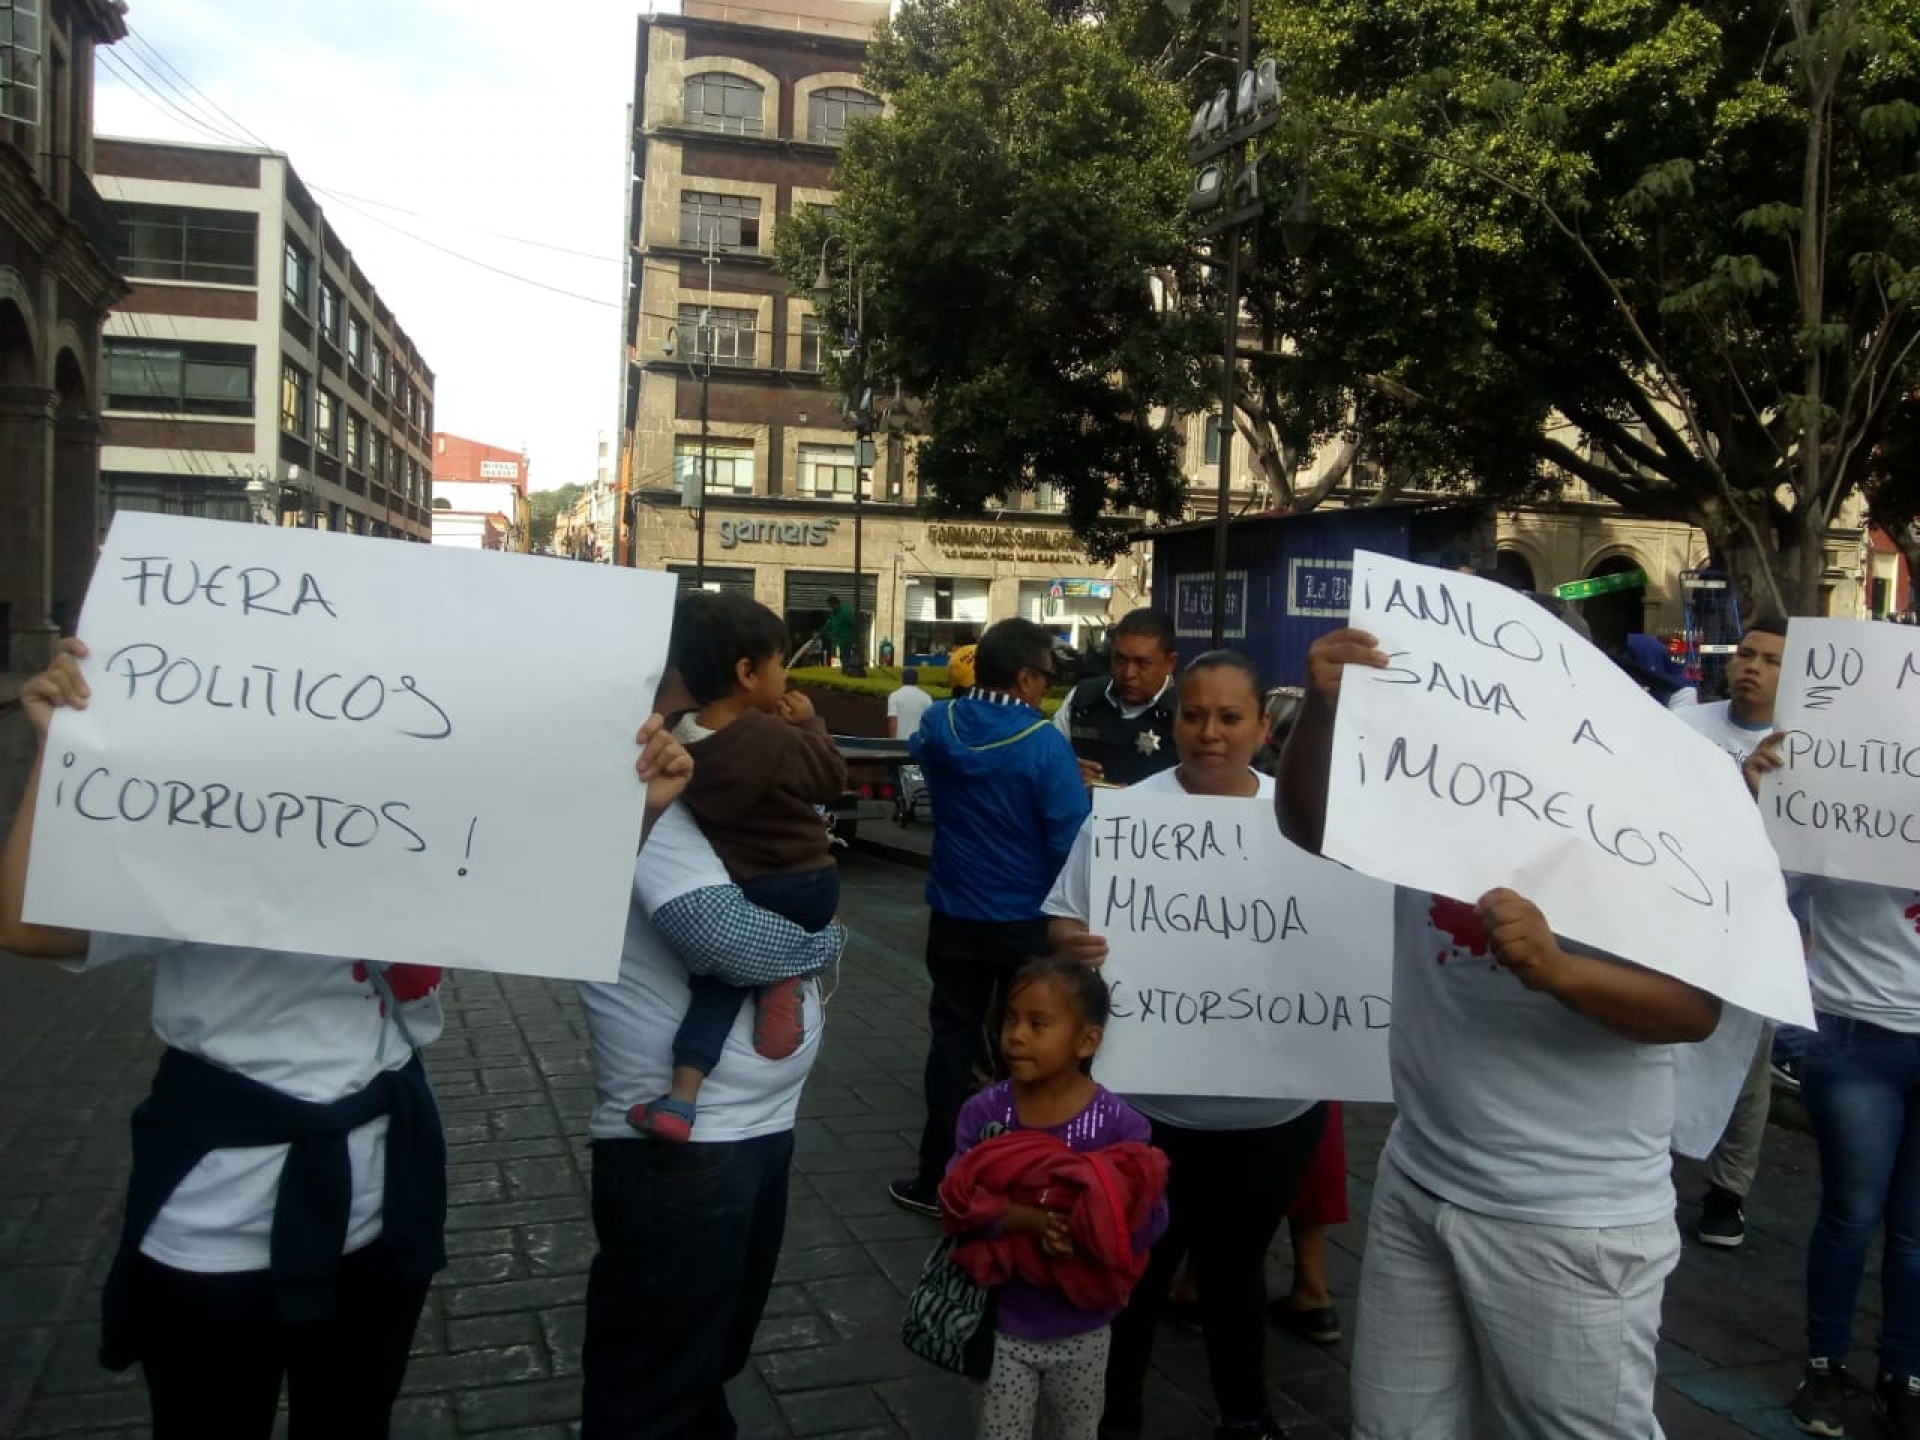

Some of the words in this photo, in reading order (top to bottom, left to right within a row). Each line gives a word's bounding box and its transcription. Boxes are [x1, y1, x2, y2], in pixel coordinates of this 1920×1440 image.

[719, 517, 836, 548] gamers
[120, 556, 337, 618] FUERA
[105, 643, 452, 739] POLITICOS
[1806, 643, 1863, 686] NO
[1371, 653, 1527, 721] SALVA
[1572, 717, 1615, 756] A
[1104, 875, 1308, 943] MAGANDA
[1109, 980, 1392, 1032] EXTORSIONAD
